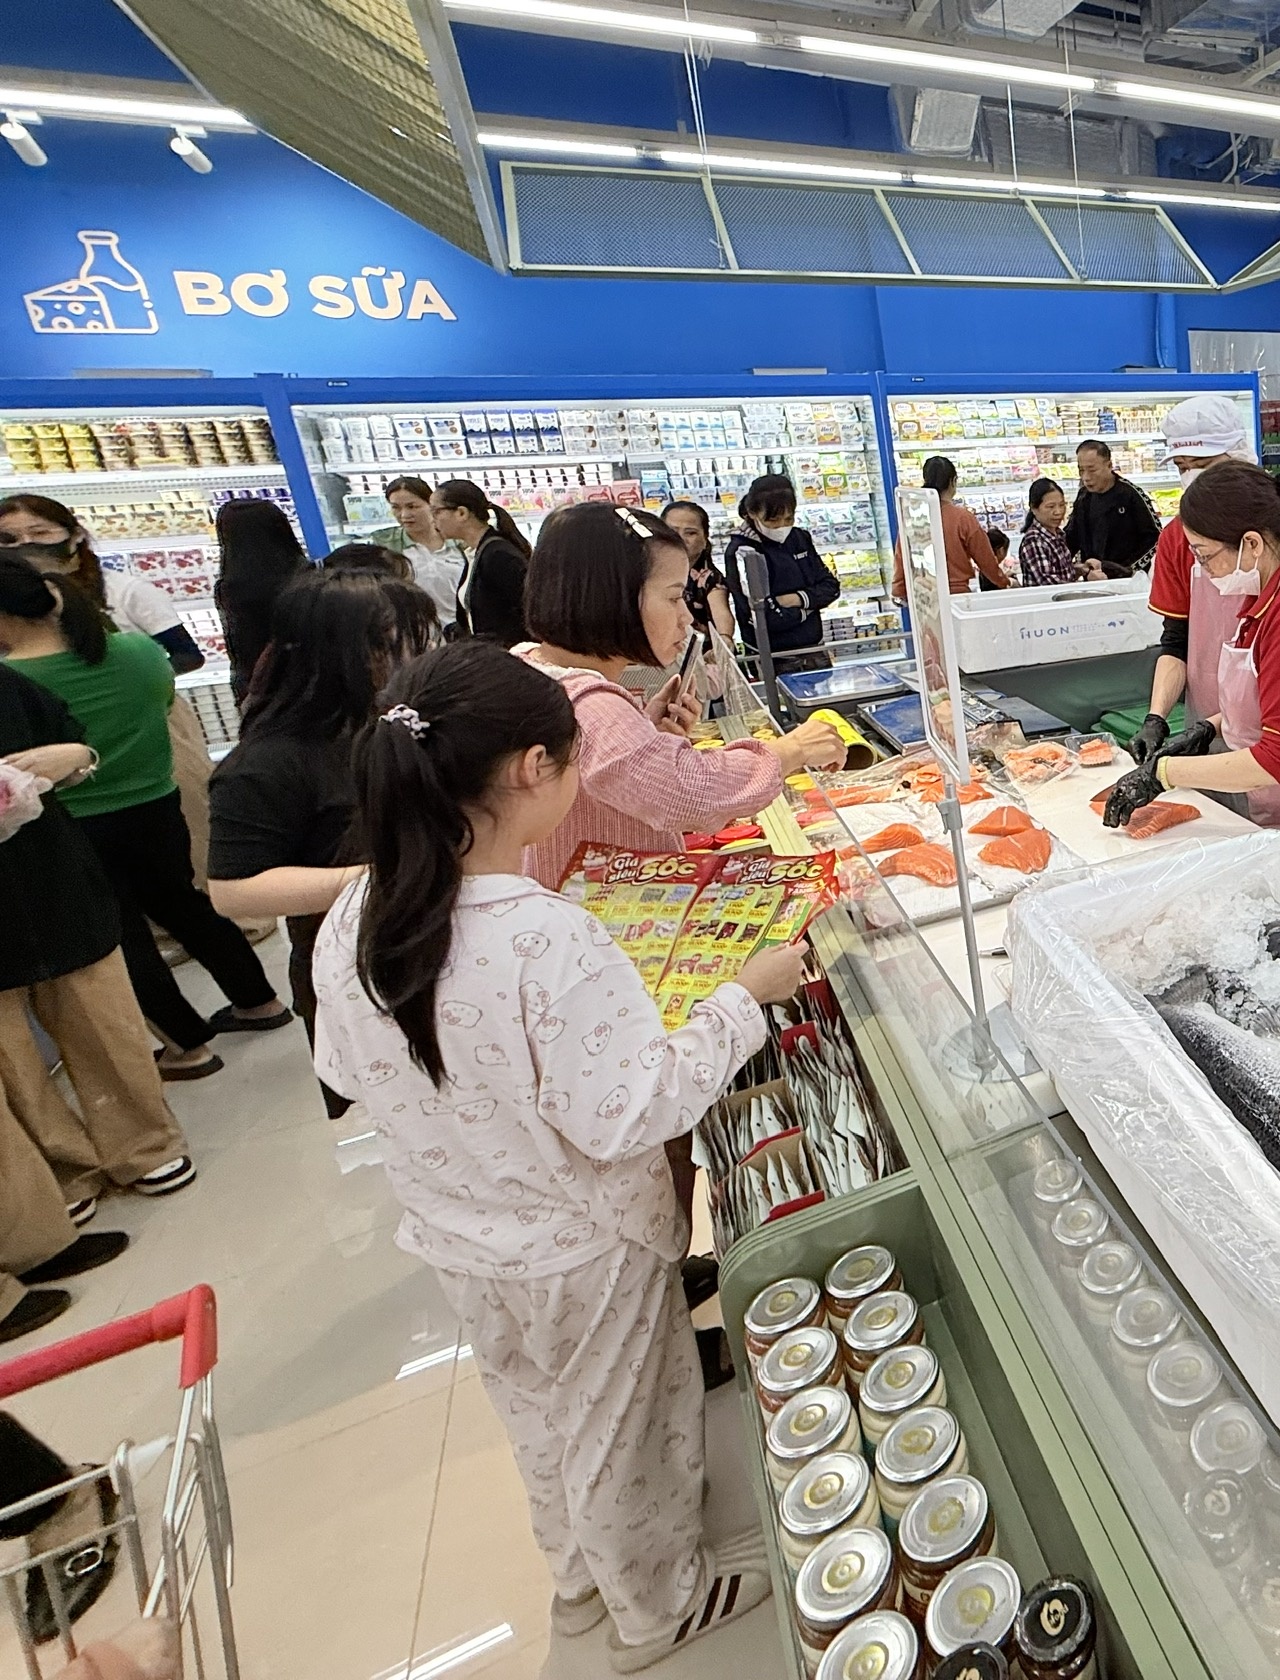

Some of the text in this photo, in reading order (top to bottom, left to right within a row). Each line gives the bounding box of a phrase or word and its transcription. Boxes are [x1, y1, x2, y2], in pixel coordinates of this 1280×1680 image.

[173, 266, 458, 321] BƠ SỮA
[640, 855, 698, 880] SỐC
[769, 858, 825, 882] SỐC
